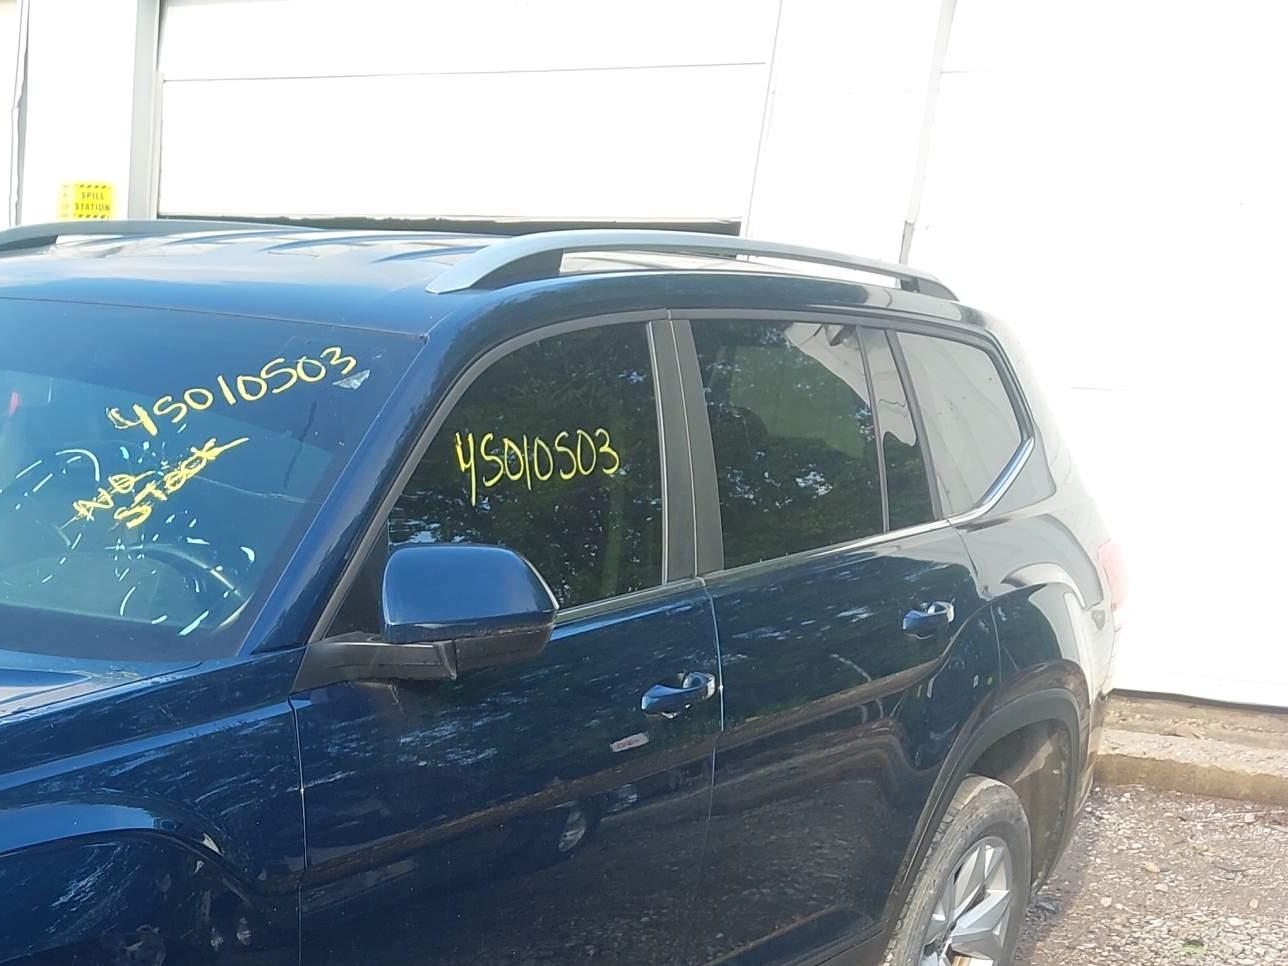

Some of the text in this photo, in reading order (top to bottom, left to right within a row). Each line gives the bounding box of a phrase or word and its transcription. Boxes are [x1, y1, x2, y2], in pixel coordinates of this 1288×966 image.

[74, 202, 111, 212] STATION
[81, 191, 105, 201] SPILL
[106, 345, 357, 436] 45010503
[455, 428, 620, 507] 45010503
